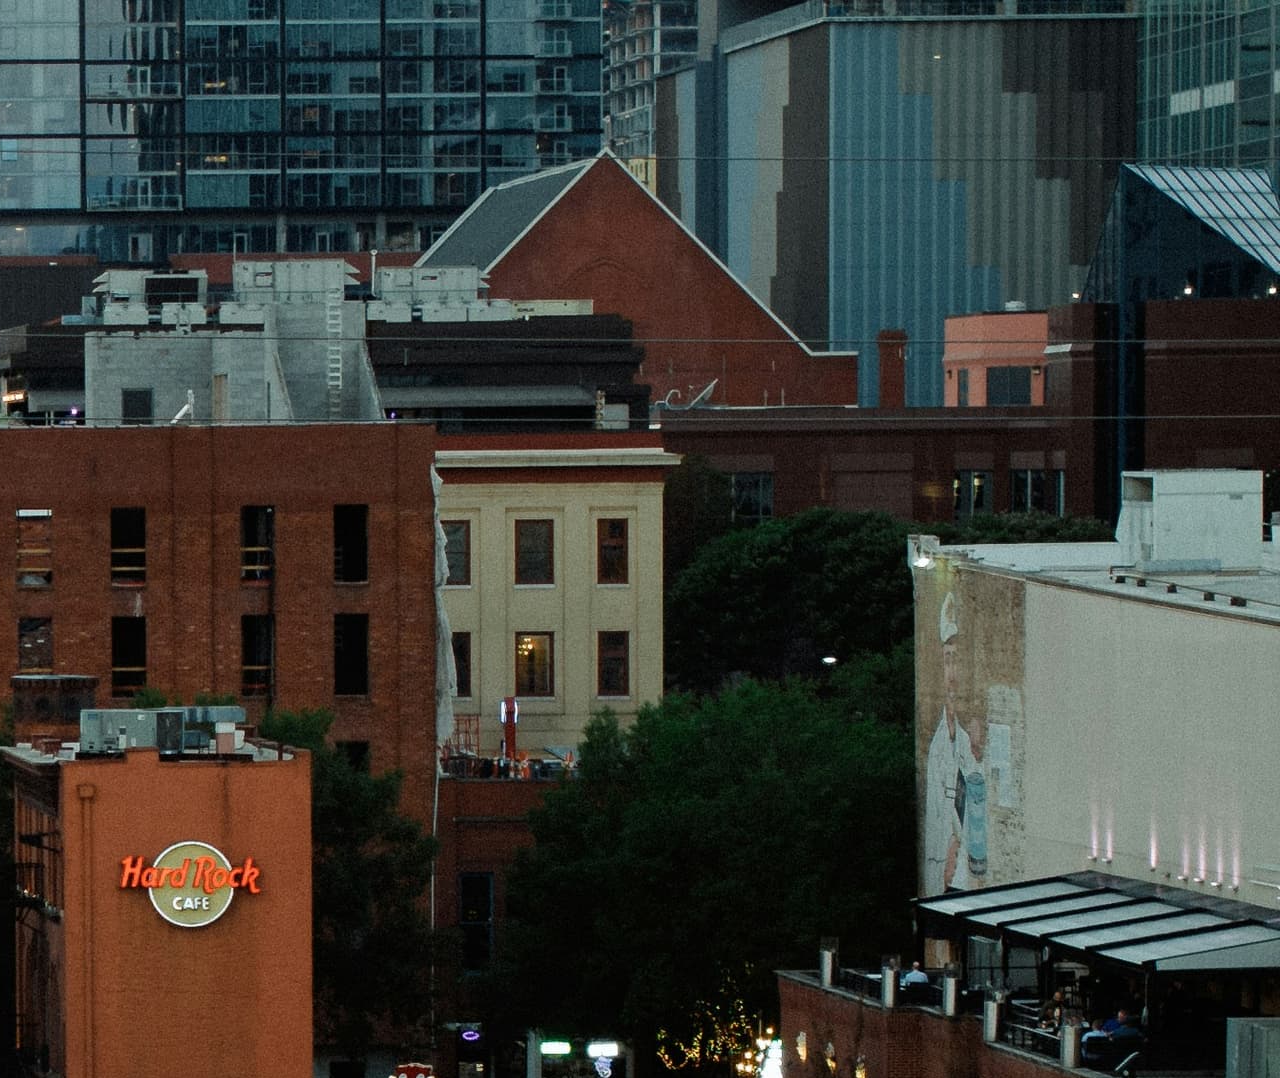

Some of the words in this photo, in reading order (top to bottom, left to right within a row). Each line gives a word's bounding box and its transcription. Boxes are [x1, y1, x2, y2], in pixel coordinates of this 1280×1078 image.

[120, 855, 191, 888] Hard
[193, 856, 261, 894] Rock
[172, 896, 209, 910] CAFE
